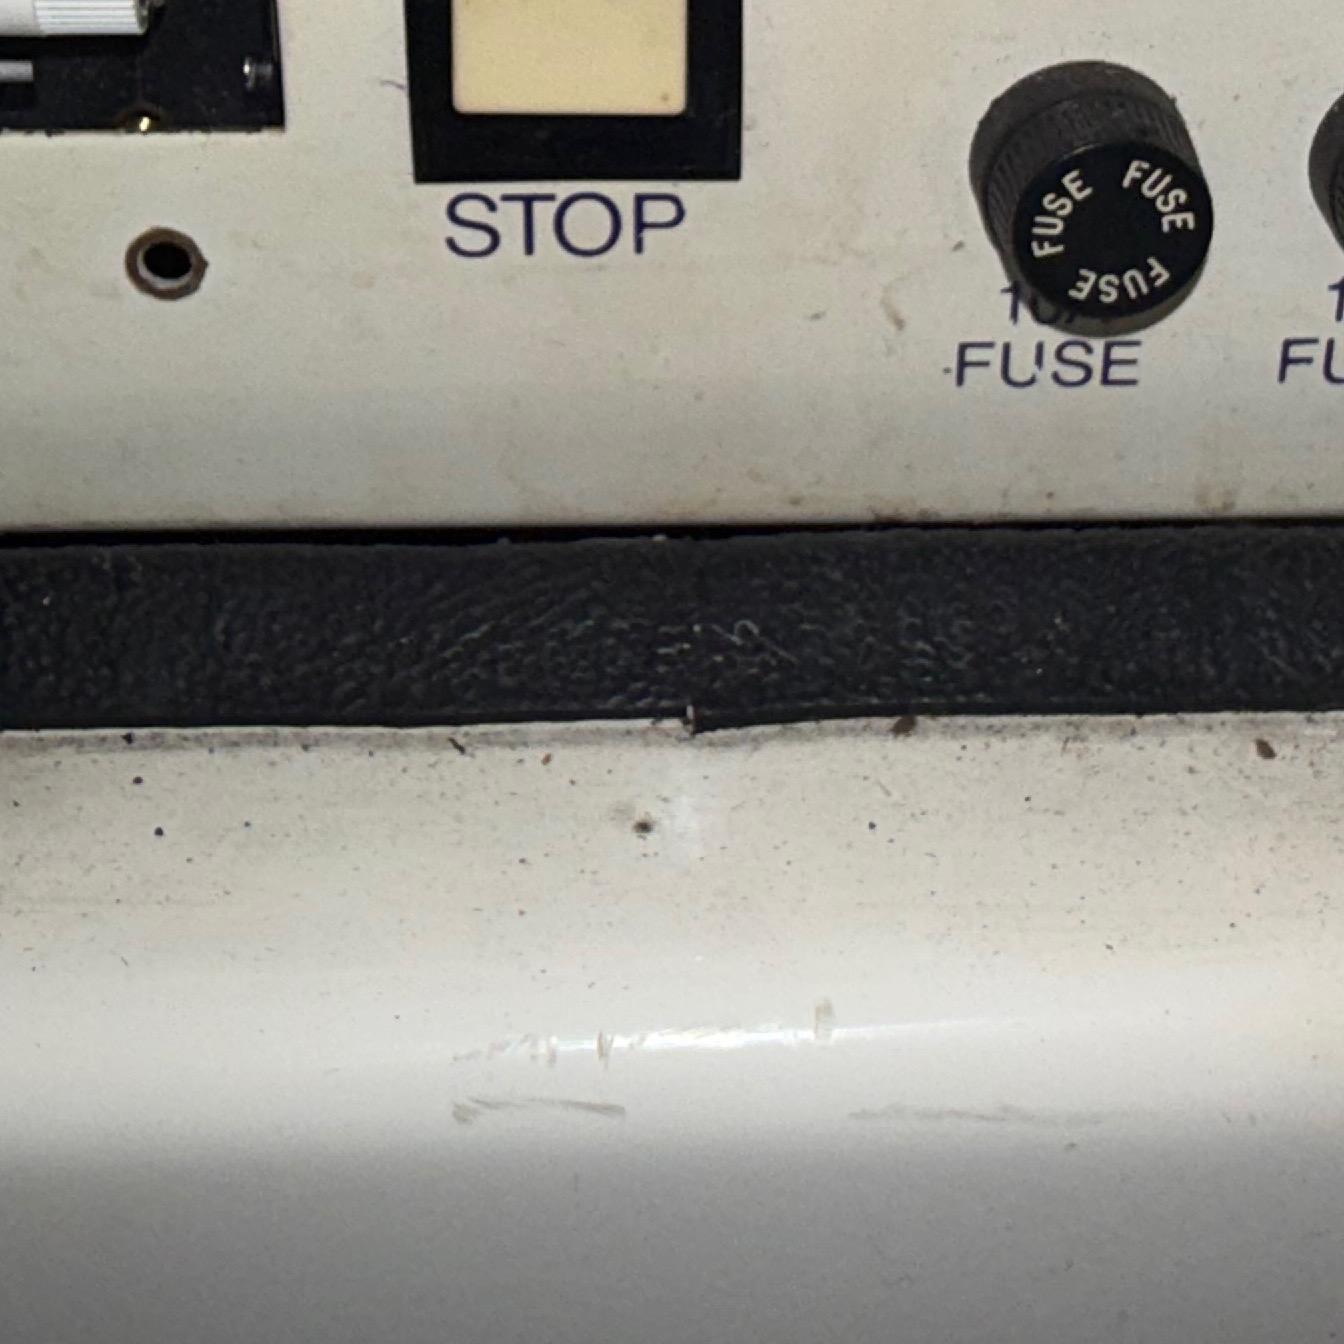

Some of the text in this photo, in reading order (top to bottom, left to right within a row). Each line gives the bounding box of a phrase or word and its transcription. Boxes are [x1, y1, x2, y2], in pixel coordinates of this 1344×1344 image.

[443, 192, 686, 257] STOP
[1030, 167, 1093, 259] FUSE
[1120, 158, 1196, 234] FUSE
[1067, 255, 1171, 304] FUSE
[955, 339, 1144, 388] FUSE
